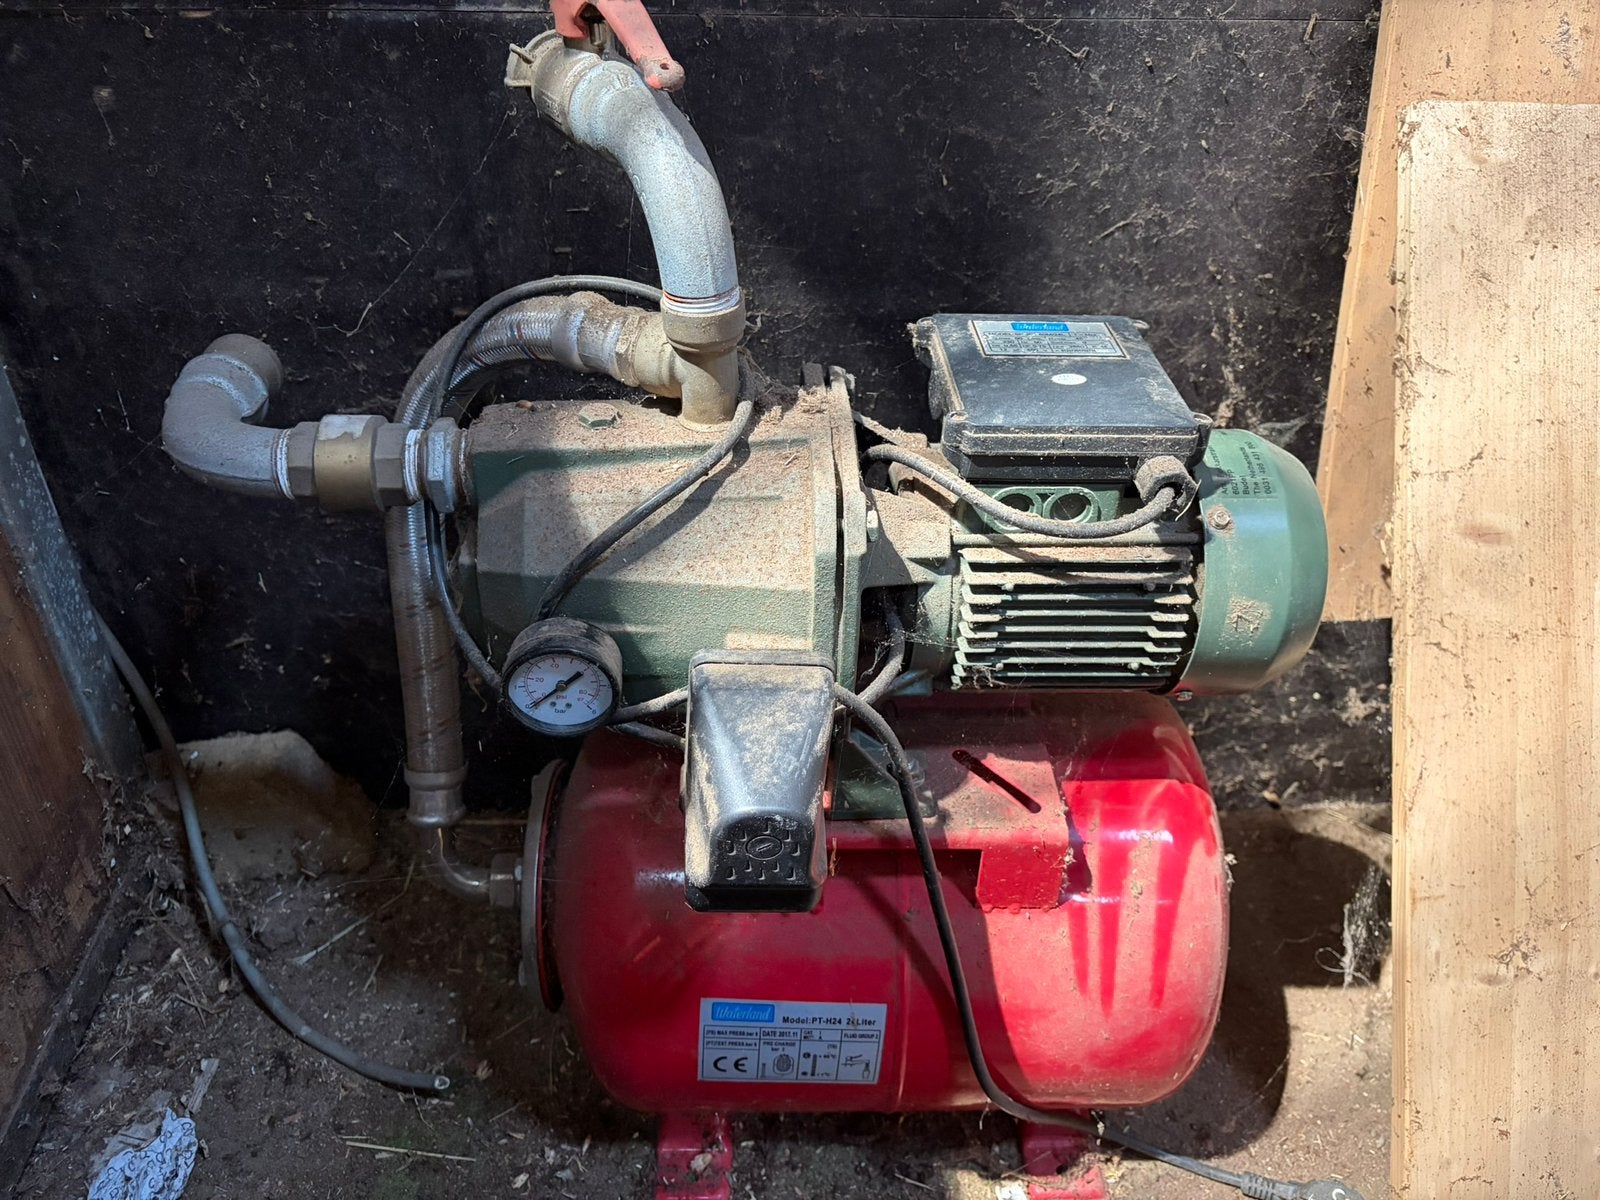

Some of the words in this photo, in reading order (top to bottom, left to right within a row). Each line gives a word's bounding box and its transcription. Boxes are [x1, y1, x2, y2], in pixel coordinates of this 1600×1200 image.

[1239, 475, 1250, 495] Budel
[1253, 482, 1261, 495] The
[1262, 477, 1272, 495] 0031
[716, 1006, 772, 1020] Waterland
[856, 1019, 877, 1027] Liter
